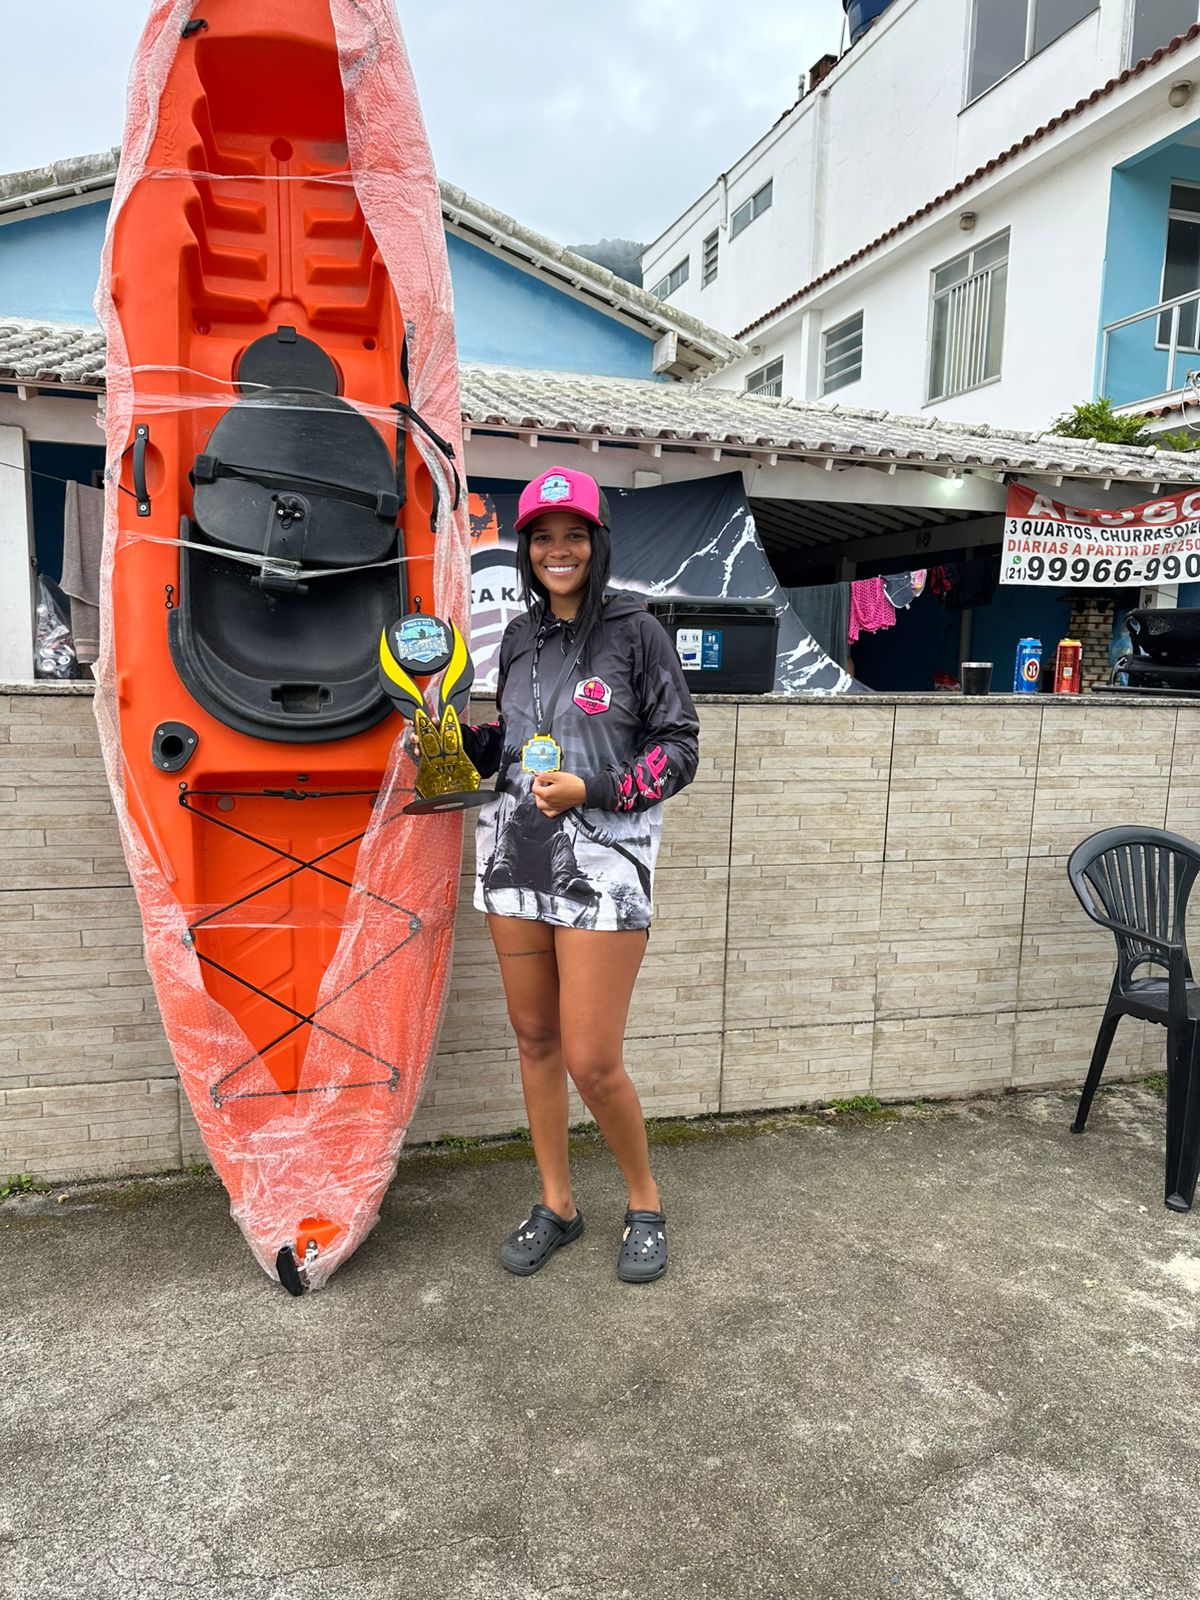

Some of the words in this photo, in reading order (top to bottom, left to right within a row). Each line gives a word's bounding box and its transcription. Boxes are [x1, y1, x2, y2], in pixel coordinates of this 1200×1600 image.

[1009, 519, 1018, 535] 3
[1021, 520, 1098, 543] QUARTOS,
[1007, 537, 1069, 555] DIÁRIAS
[1072, 543, 1082, 556] A
[1086, 543, 1138, 557] PARTIR
[1142, 543, 1161, 556] DE
[1005, 567, 1027, 579] (21)
[1027, 553, 1200, 583] 99966-990
